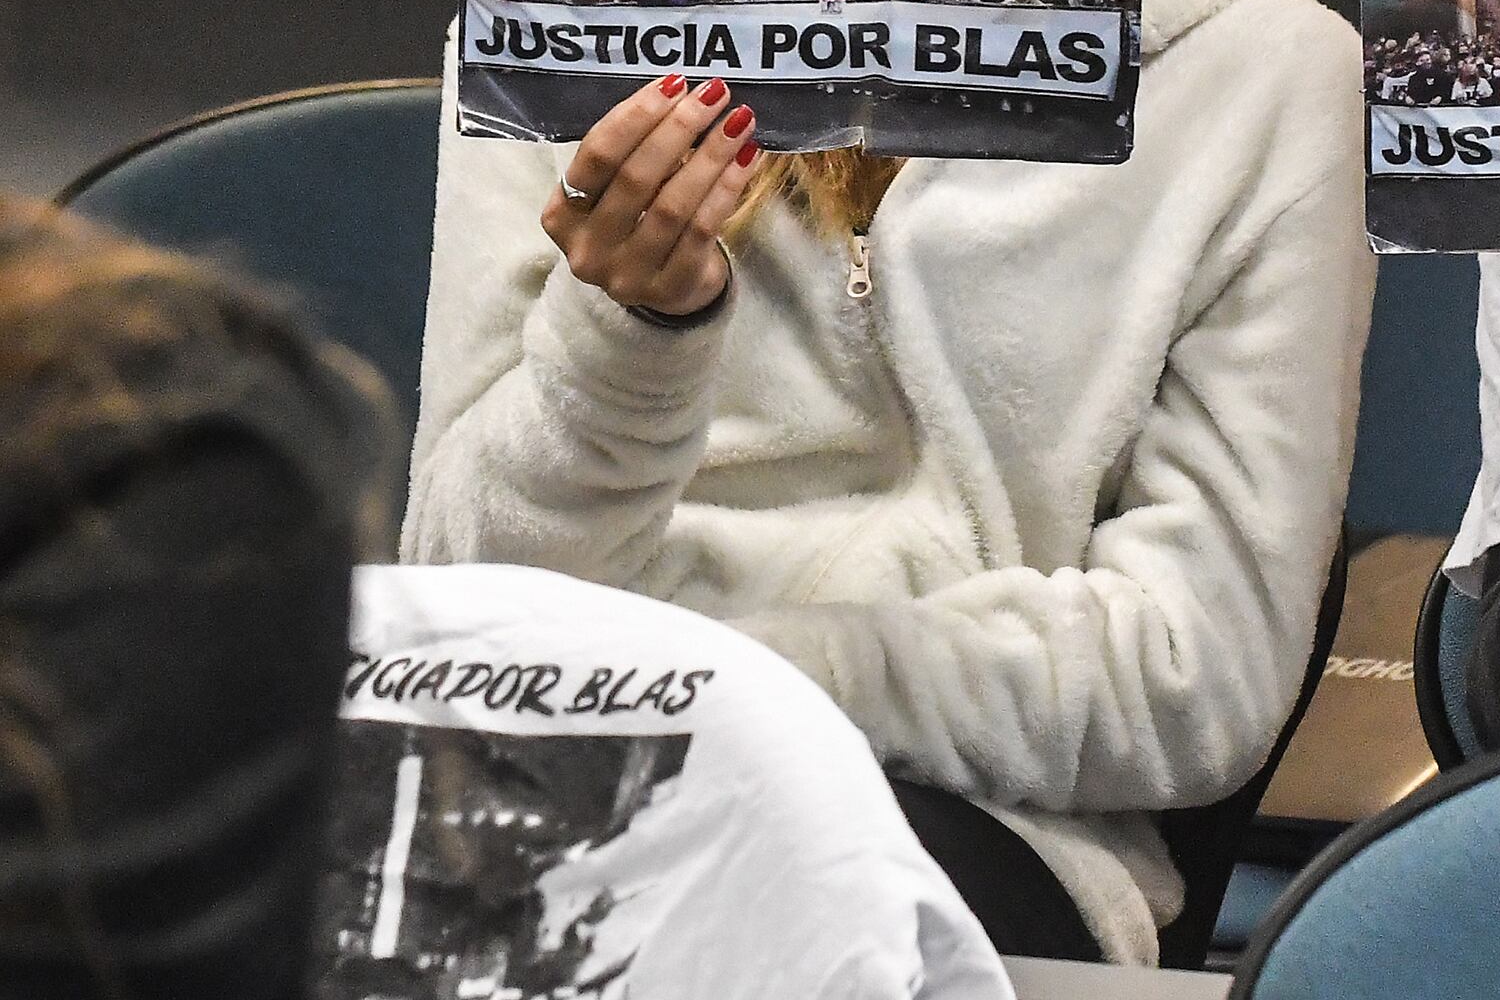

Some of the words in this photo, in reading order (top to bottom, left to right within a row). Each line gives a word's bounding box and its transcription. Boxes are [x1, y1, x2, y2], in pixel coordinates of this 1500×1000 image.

[475, 18, 741, 69] JUSTICIA
[761, 23, 893, 70] POR
[915, 24, 1107, 83] BLAS
[564, 668, 714, 716] BLAS
